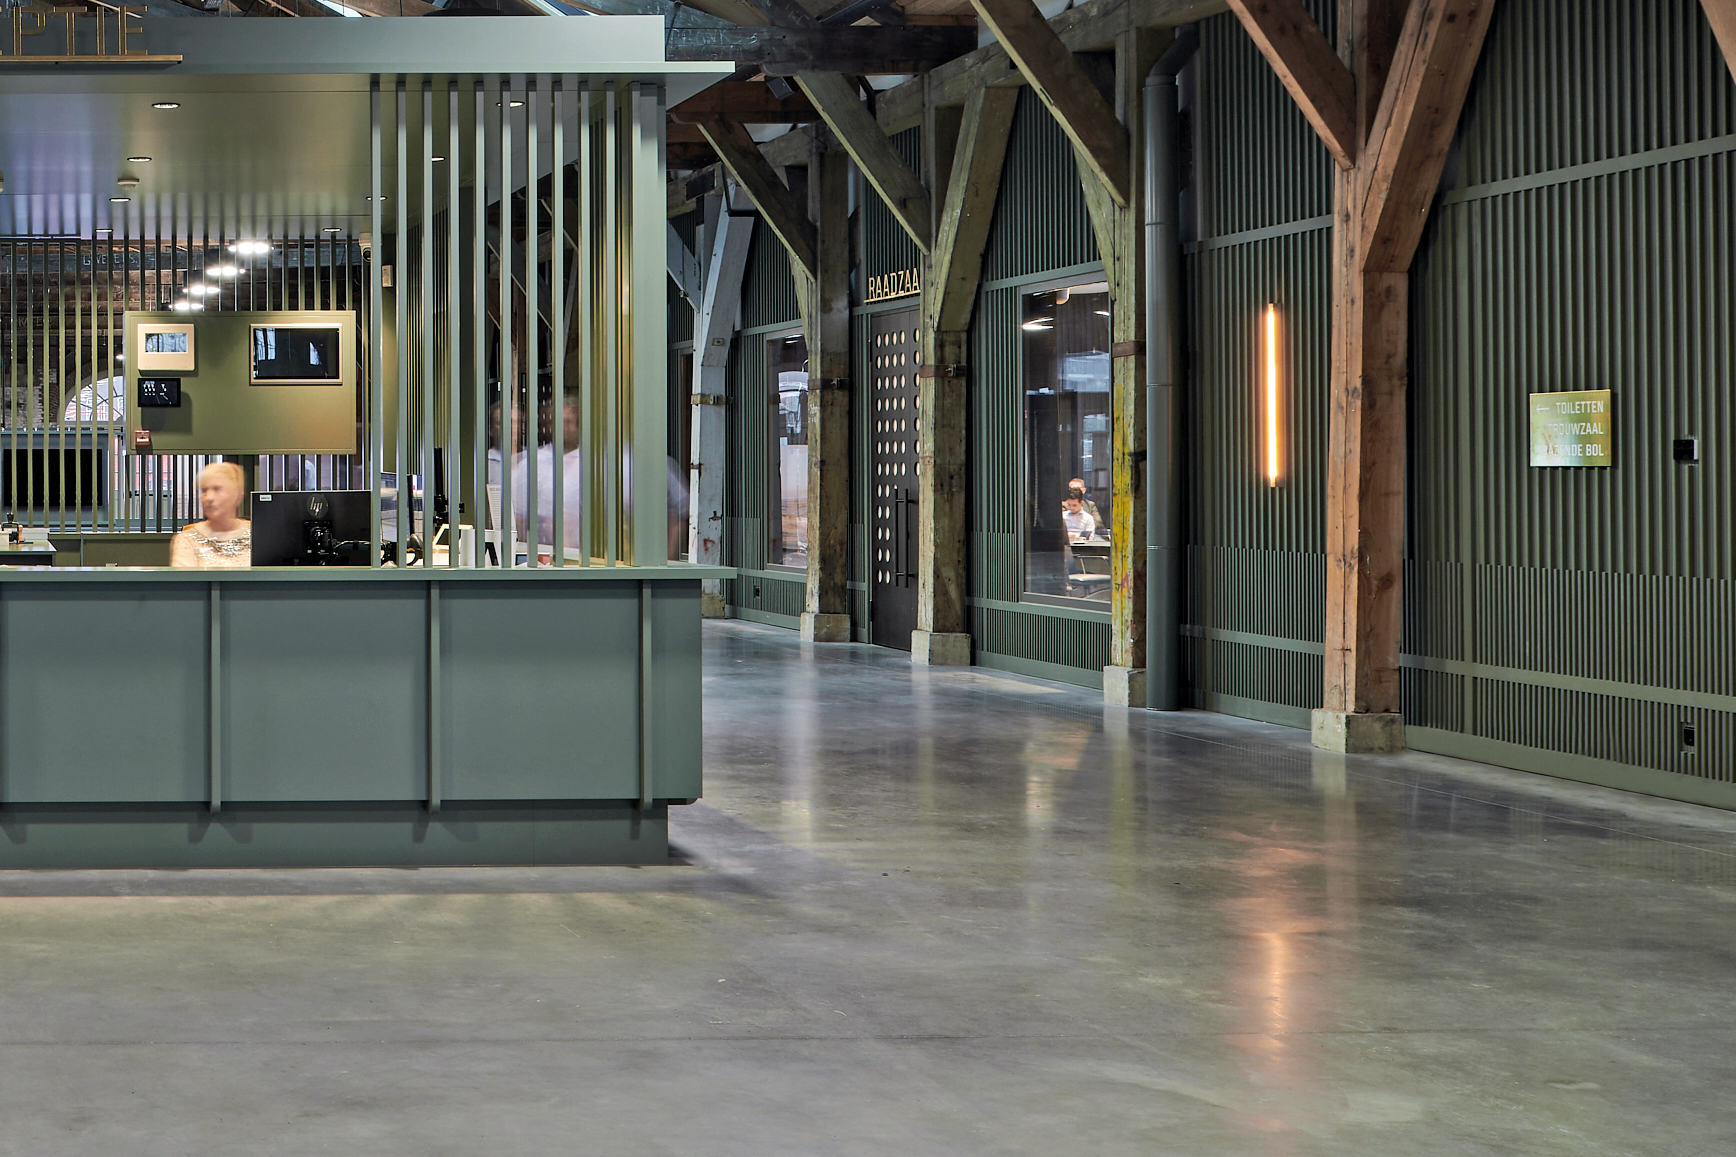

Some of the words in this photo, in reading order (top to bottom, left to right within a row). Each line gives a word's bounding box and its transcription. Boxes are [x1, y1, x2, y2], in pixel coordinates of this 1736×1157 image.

[868, 267, 921, 301] RAADZAA
[1555, 400, 1604, 415] TOILETTEN
[1547, 422, 1605, 436] TROUWZAAL
[1543, 443, 1584, 457] RAZENDE
[1585, 443, 1605, 457] BOL
